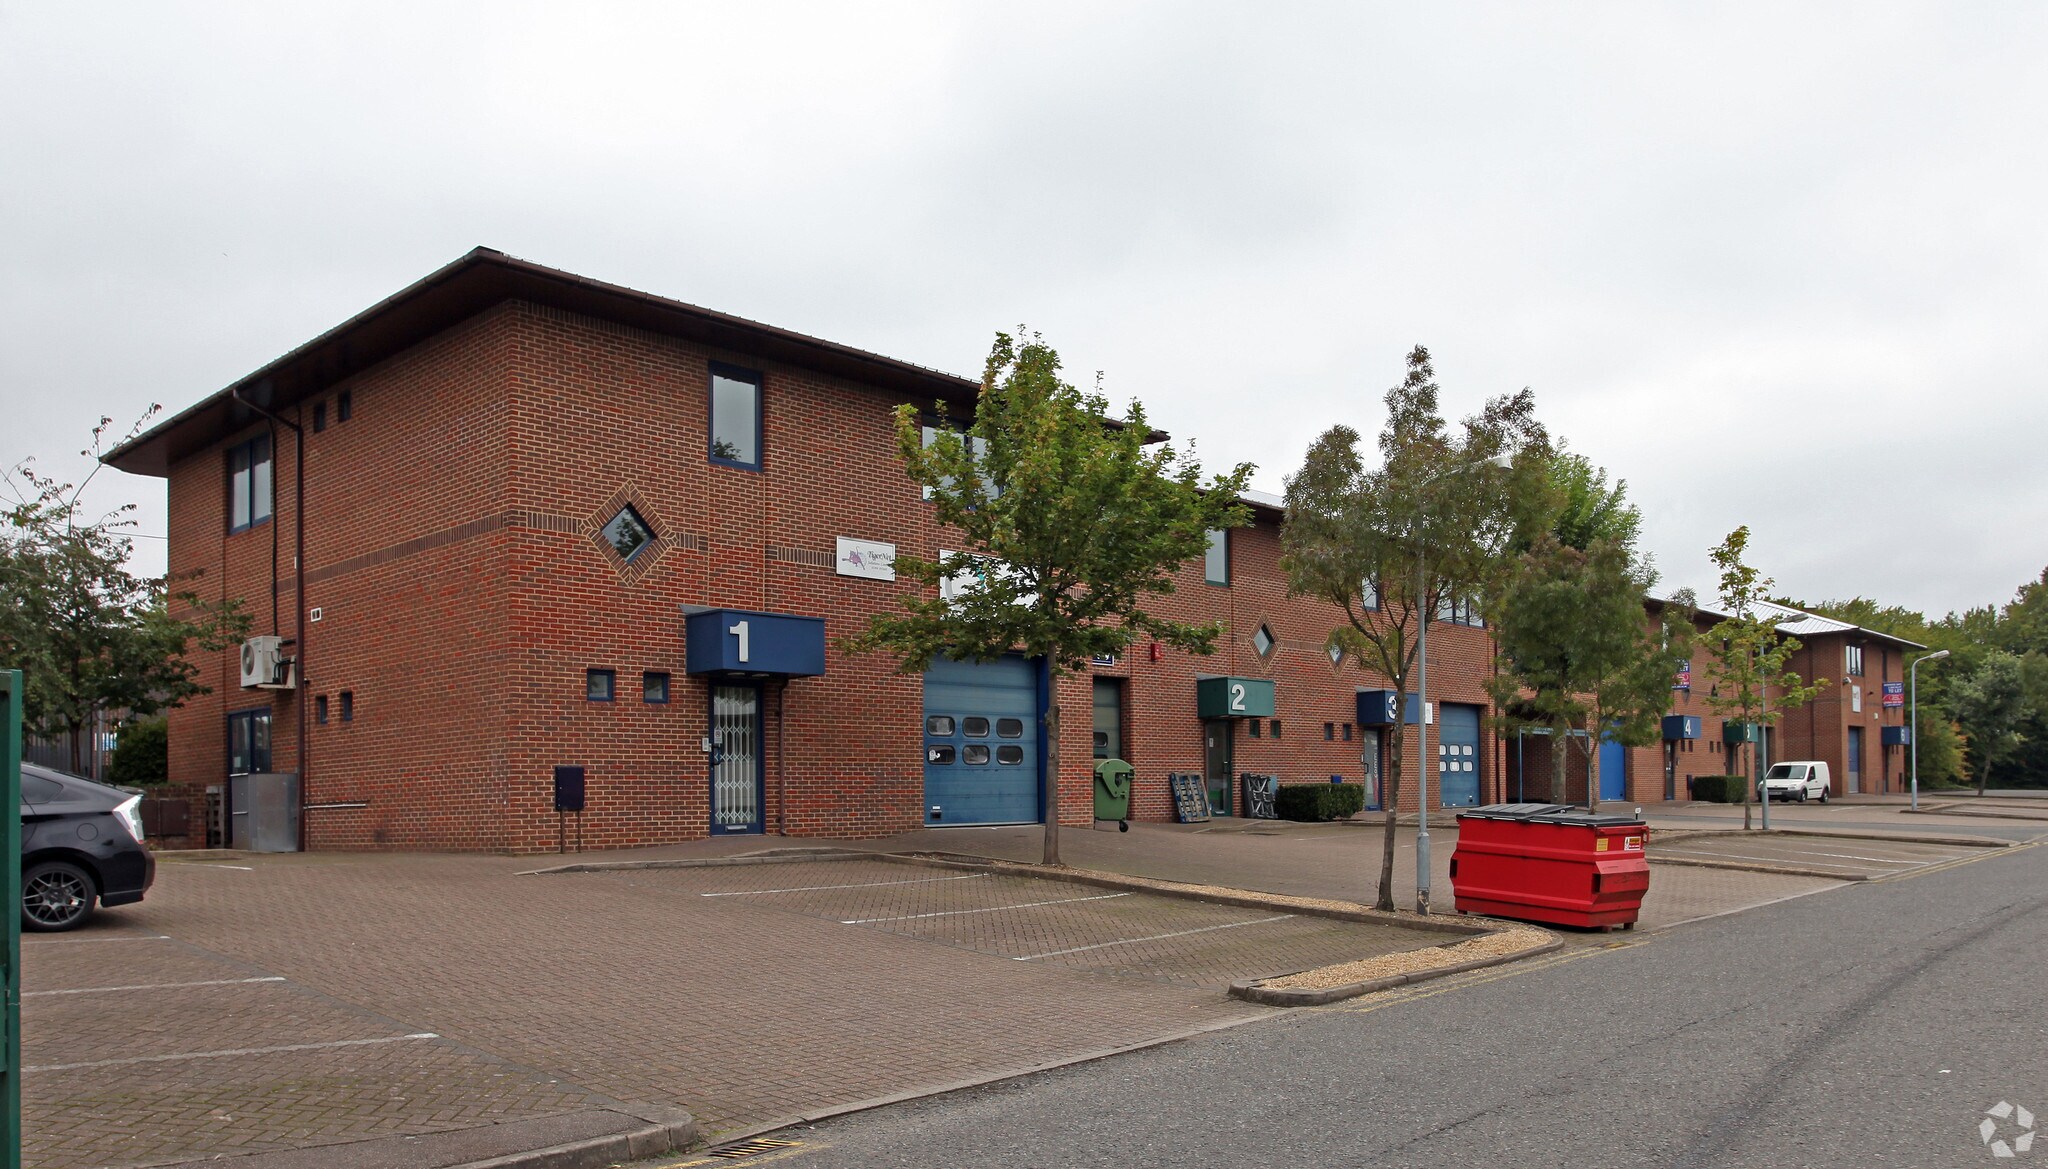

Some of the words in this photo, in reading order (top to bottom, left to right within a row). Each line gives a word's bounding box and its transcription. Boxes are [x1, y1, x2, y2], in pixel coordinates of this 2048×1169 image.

[729, 620, 749, 662] 1
[1231, 684, 1246, 711] 2
[1388, 695, 1397, 719] 3
[1685, 719, 1691, 735] 4
